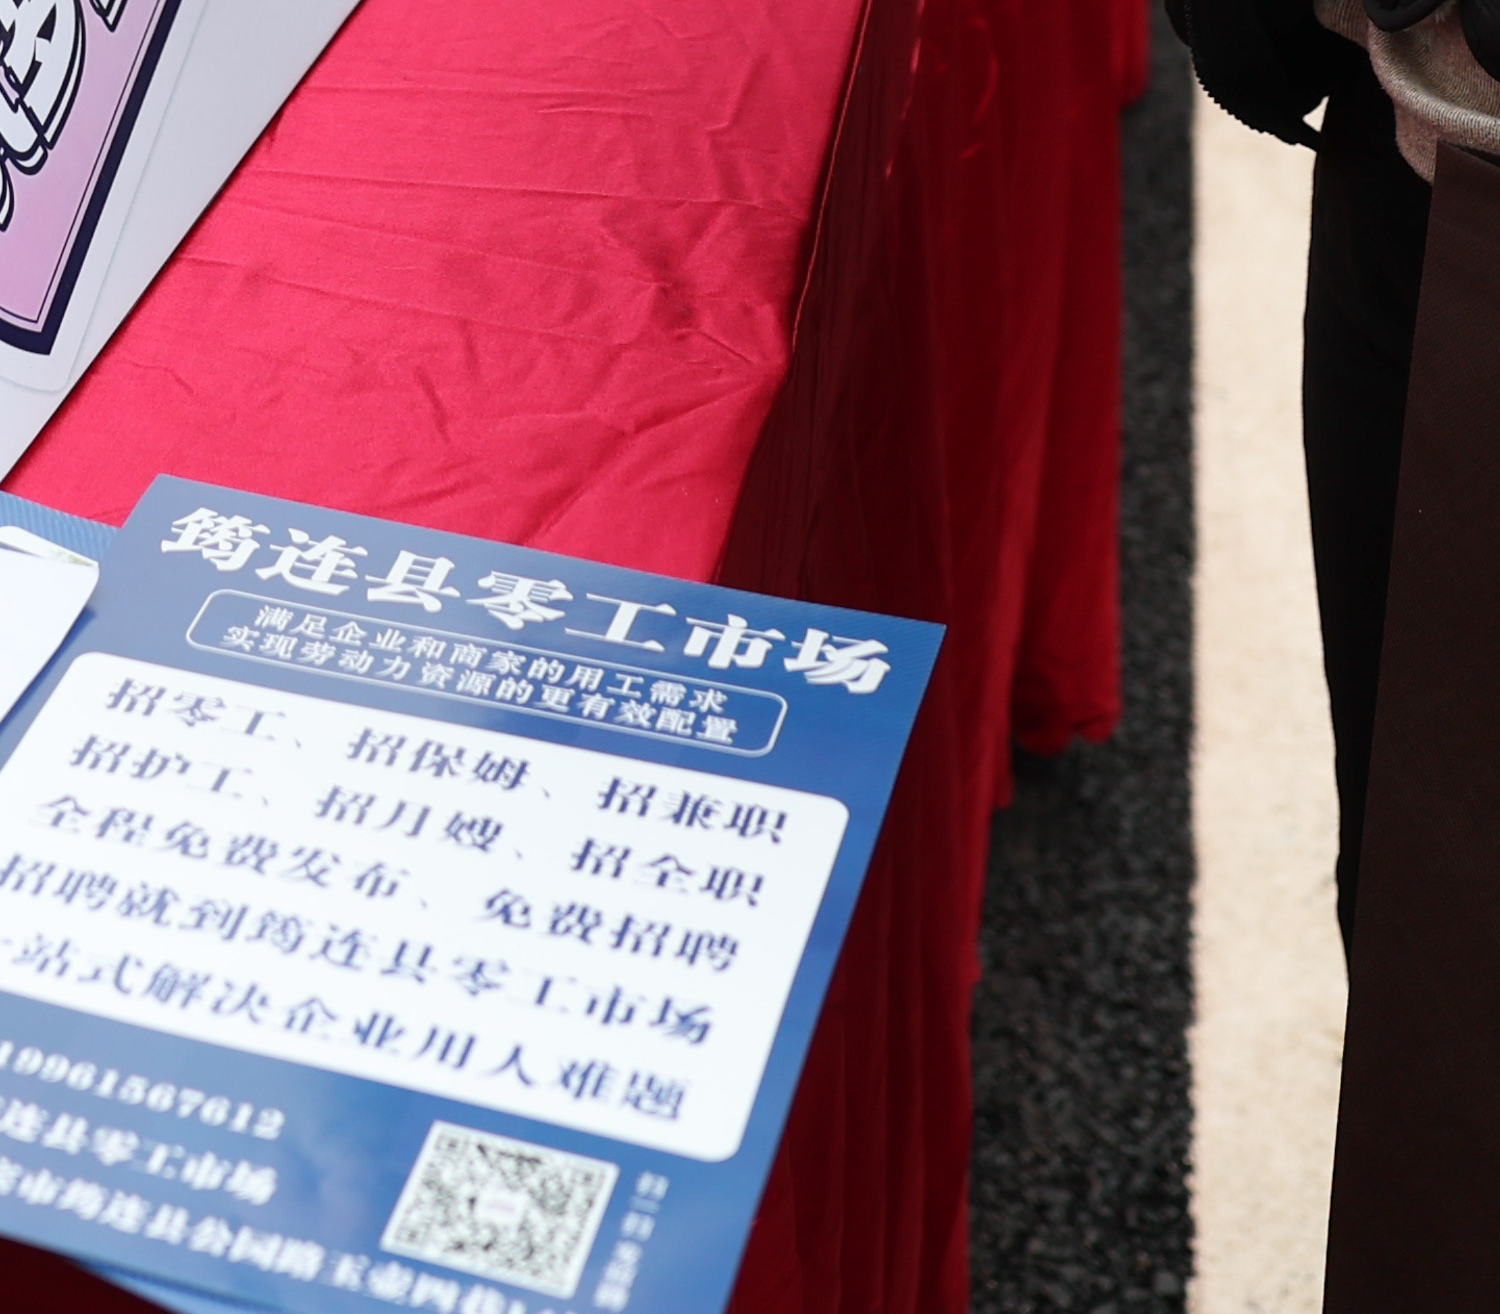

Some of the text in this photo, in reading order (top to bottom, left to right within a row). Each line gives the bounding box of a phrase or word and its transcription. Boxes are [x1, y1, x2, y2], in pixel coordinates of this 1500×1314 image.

[159, 505, 894, 699] 筠连县零工市场
[220, 623, 742, 747] 实现劳动力资源的更有效配置
[253, 601, 732, 718] 满足企业和商家的用工需求
[67, 731, 766, 912] 招护工、招月嫂、招全职
[103, 675, 790, 849] 招零工、招保姆、招兼职
[34, 792, 744, 976] 全程免费发布、免费招聘
